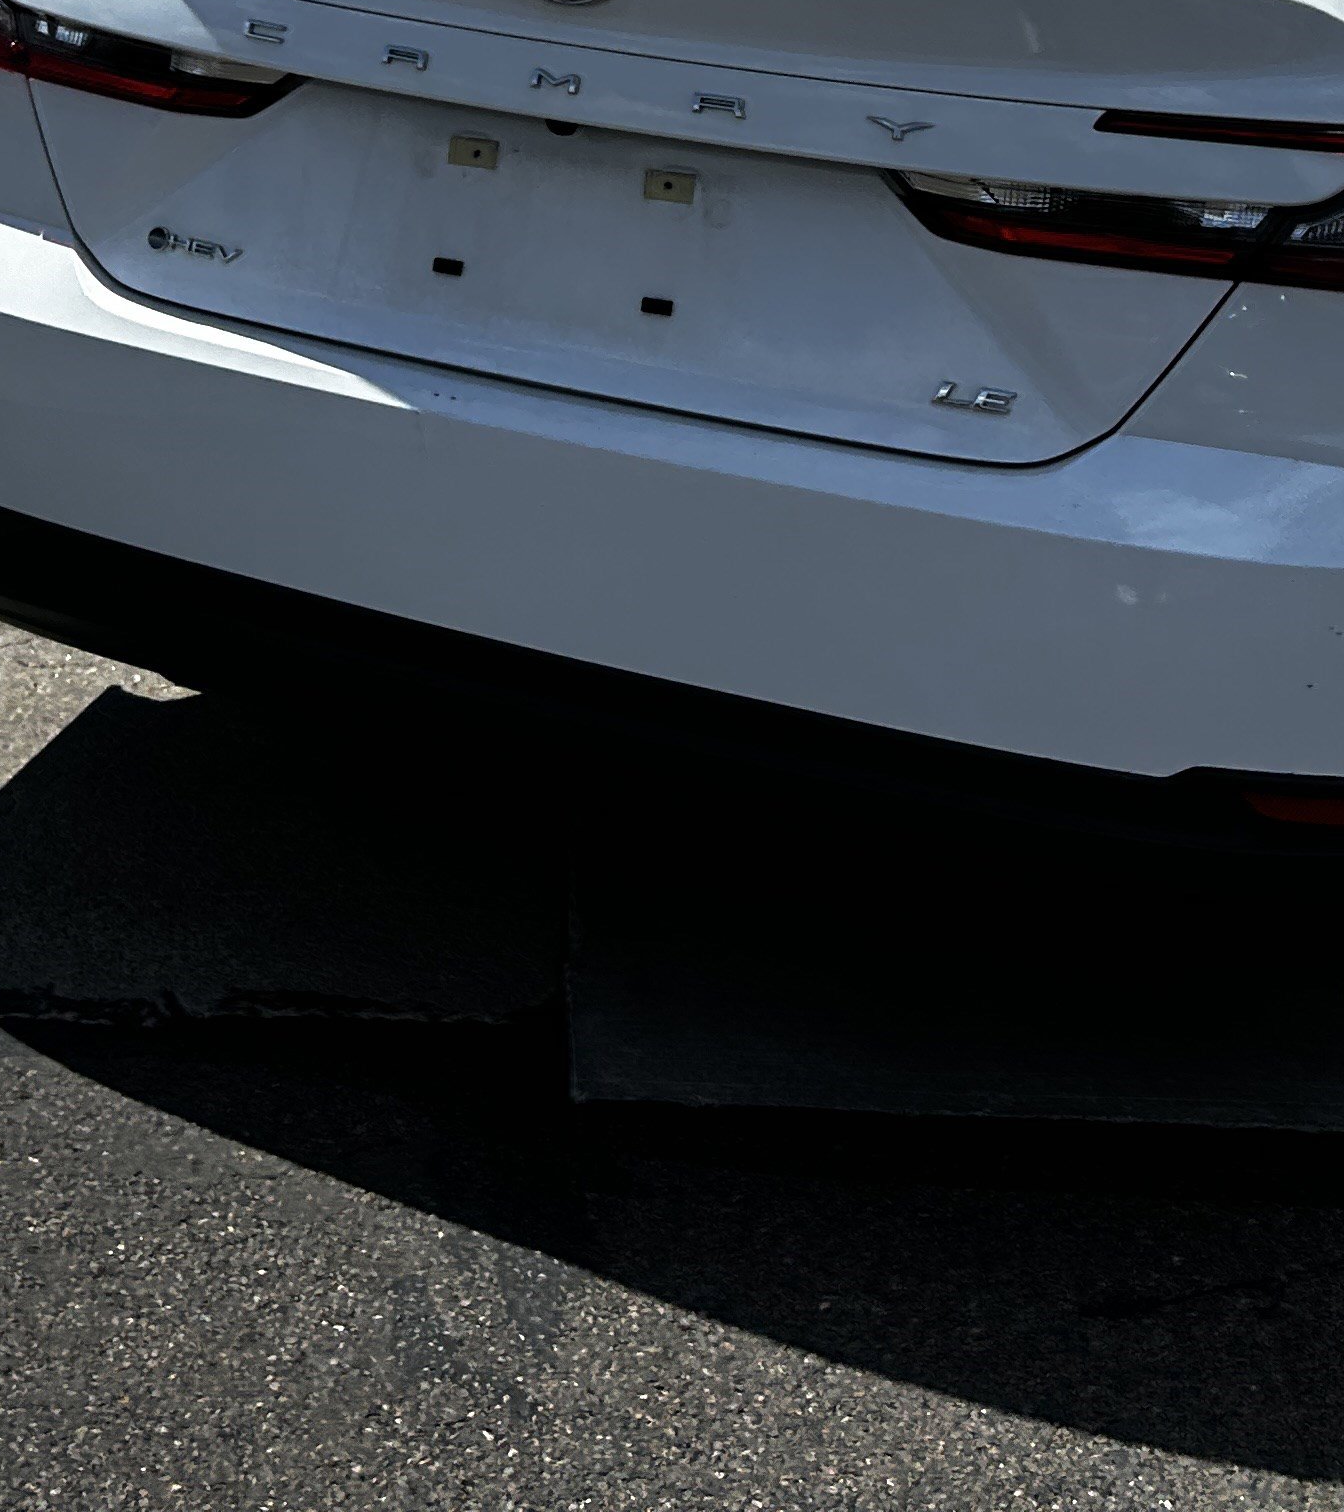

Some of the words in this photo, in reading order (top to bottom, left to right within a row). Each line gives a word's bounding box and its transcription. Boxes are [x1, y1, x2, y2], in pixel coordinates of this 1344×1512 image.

[244, 15, 937, 141] CAMRY
[169, 233, 245, 264] HEV
[931, 380, 1018, 415] LE
